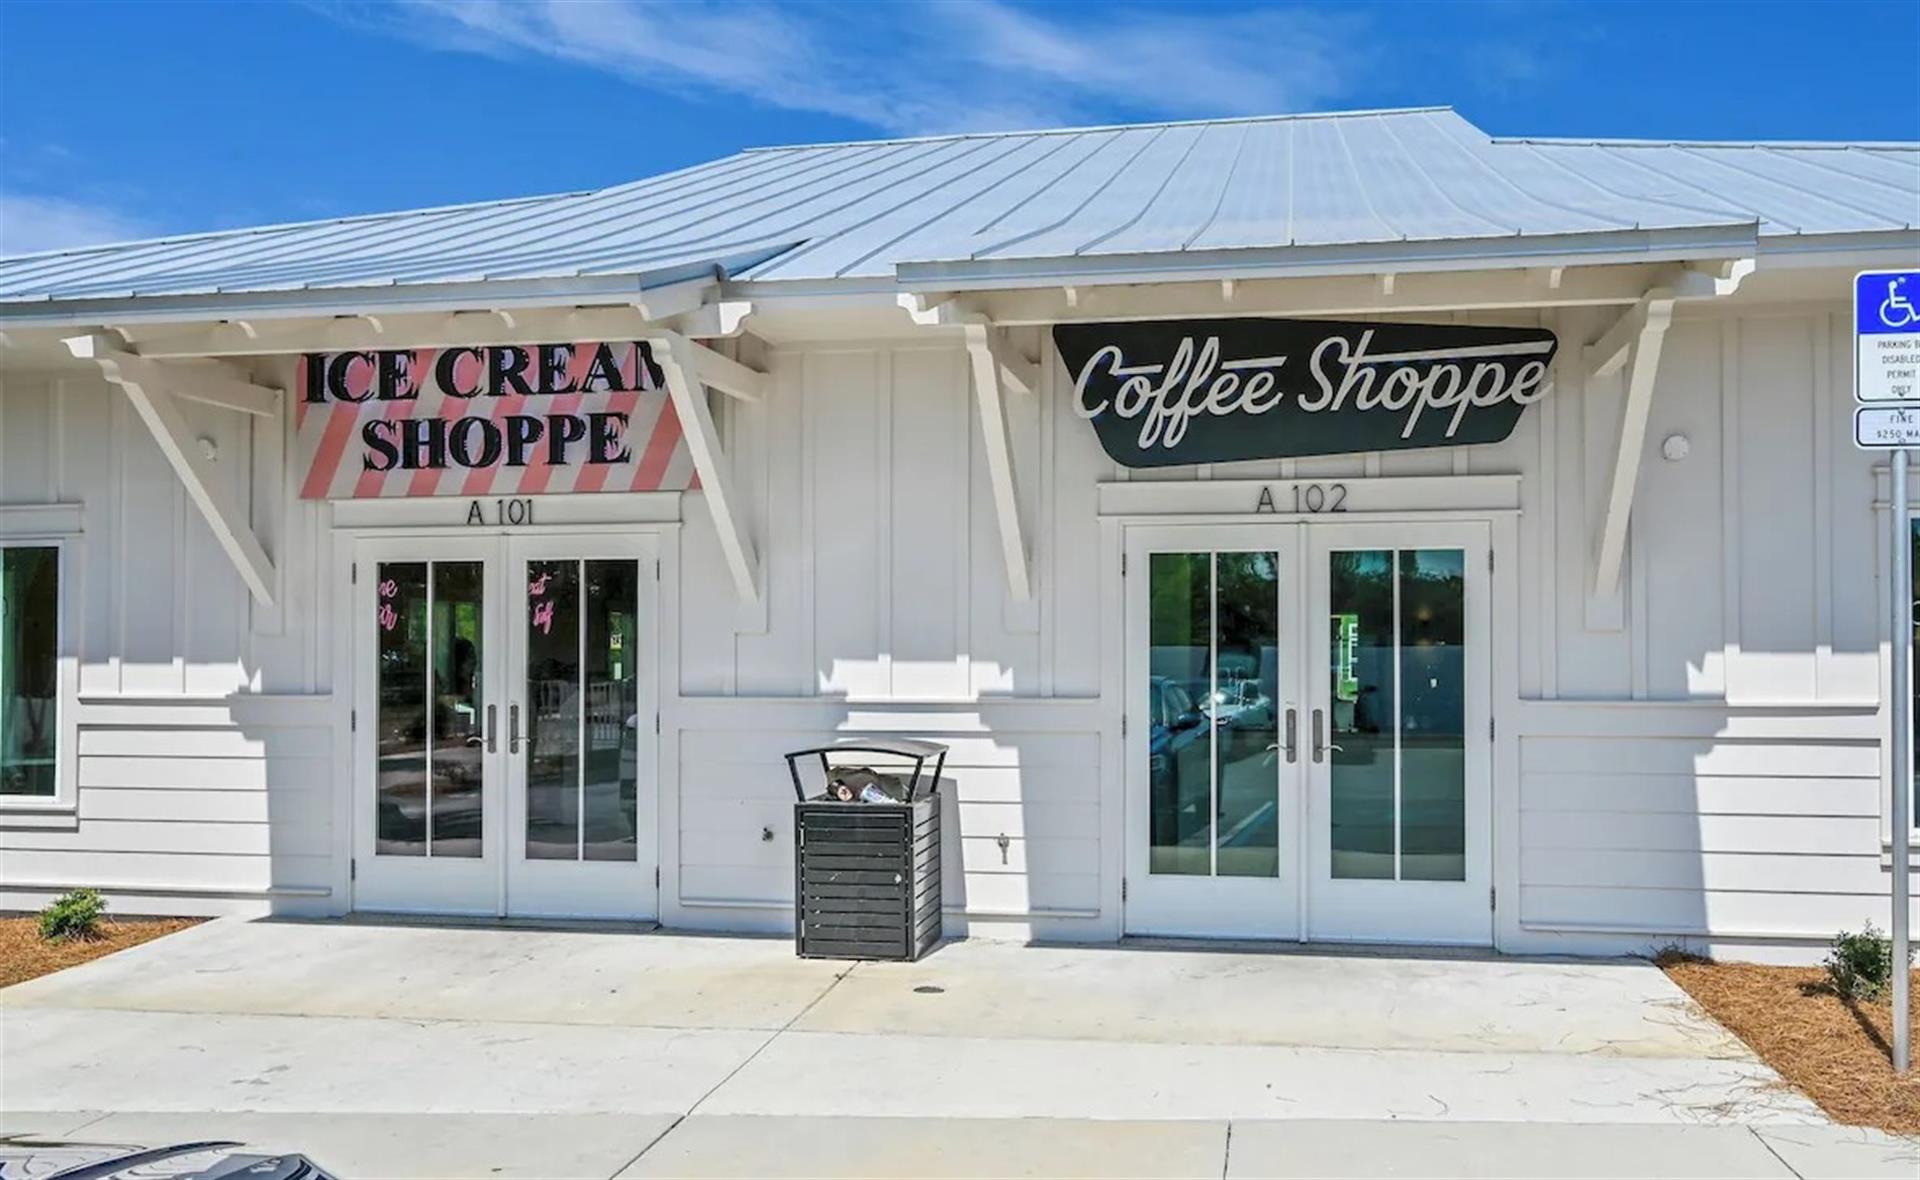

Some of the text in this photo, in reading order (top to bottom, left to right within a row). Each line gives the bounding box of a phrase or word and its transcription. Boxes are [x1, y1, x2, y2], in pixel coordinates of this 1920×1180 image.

[1877, 340, 1912, 349] PARKING
[301, 350, 419, 403] ICE
[1887, 369, 1916, 379] PERMIT
[1073, 329, 1555, 449] Coffee Shoppe
[1891, 385, 1912, 394] ONLY
[1890, 414, 1914, 424] FINE
[362, 412, 632, 471] SHOPPE
[1876, 429, 1901, 438] $250
[1256, 484, 1348, 514] A 102
[467, 499, 534, 525] A 101
